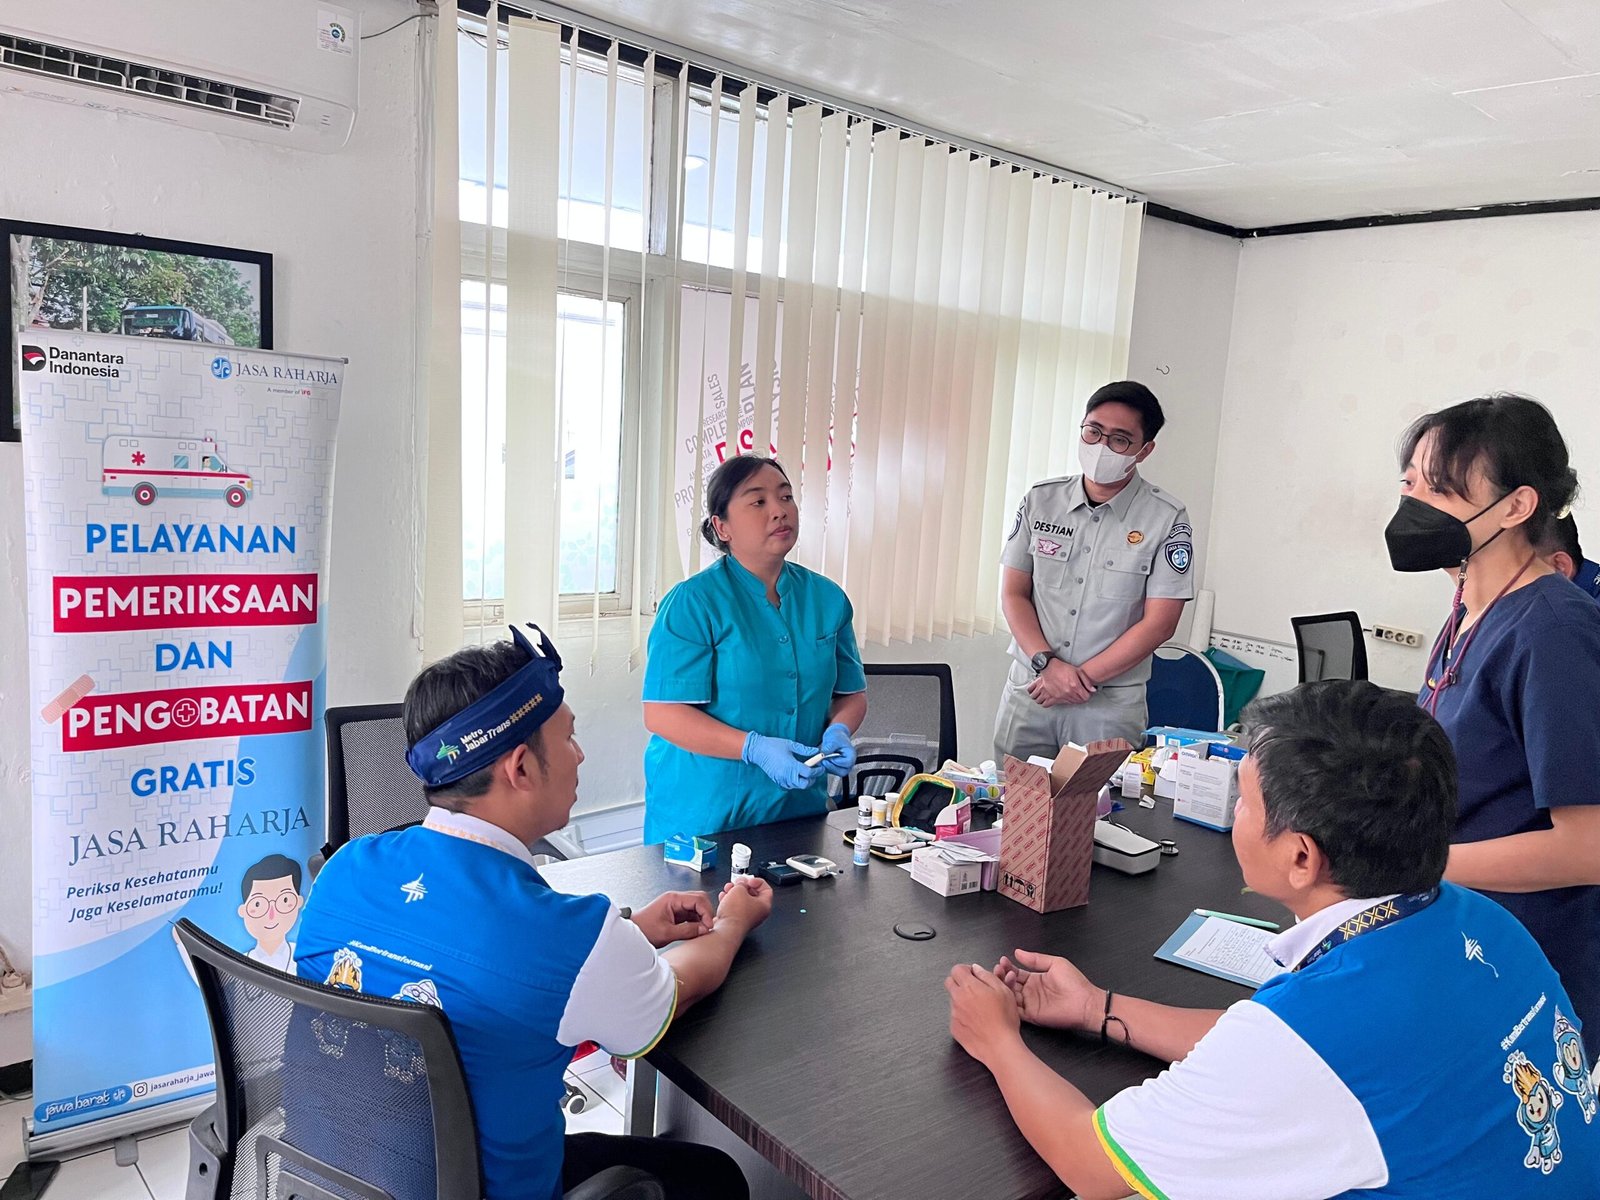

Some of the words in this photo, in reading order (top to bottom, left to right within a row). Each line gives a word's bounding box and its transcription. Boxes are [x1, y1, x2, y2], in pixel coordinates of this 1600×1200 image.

[49, 347, 124, 365] Danantara
[49, 361, 120, 378] Indonesia
[236, 363, 268, 377] JASA
[273, 366, 338, 385] RAHARJA
[708, 373, 726, 410] SALES
[704, 409, 727, 427] RESEARC
[685, 420, 727, 454] COMPLE
[86, 523, 296, 554] PELAYANAN
[1033, 521, 1074, 537] DESTIAN
[60, 584, 314, 618] PEMERIKSAAN
[155, 640, 233, 672] DAN
[460, 729, 483, 744] Metro
[131, 757, 256, 797] GRATIS
[69, 827, 148, 866] JASA
[158, 805, 310, 847] RAHARJA
[67, 880, 121, 898] Periksa
[124, 865, 219, 890] Kesehatanmu
[68, 906, 103, 923] Jaga
[106, 882, 223, 914] Keselamatanmu!
[150, 1070, 216, 1092] jasaraharja_jawa
